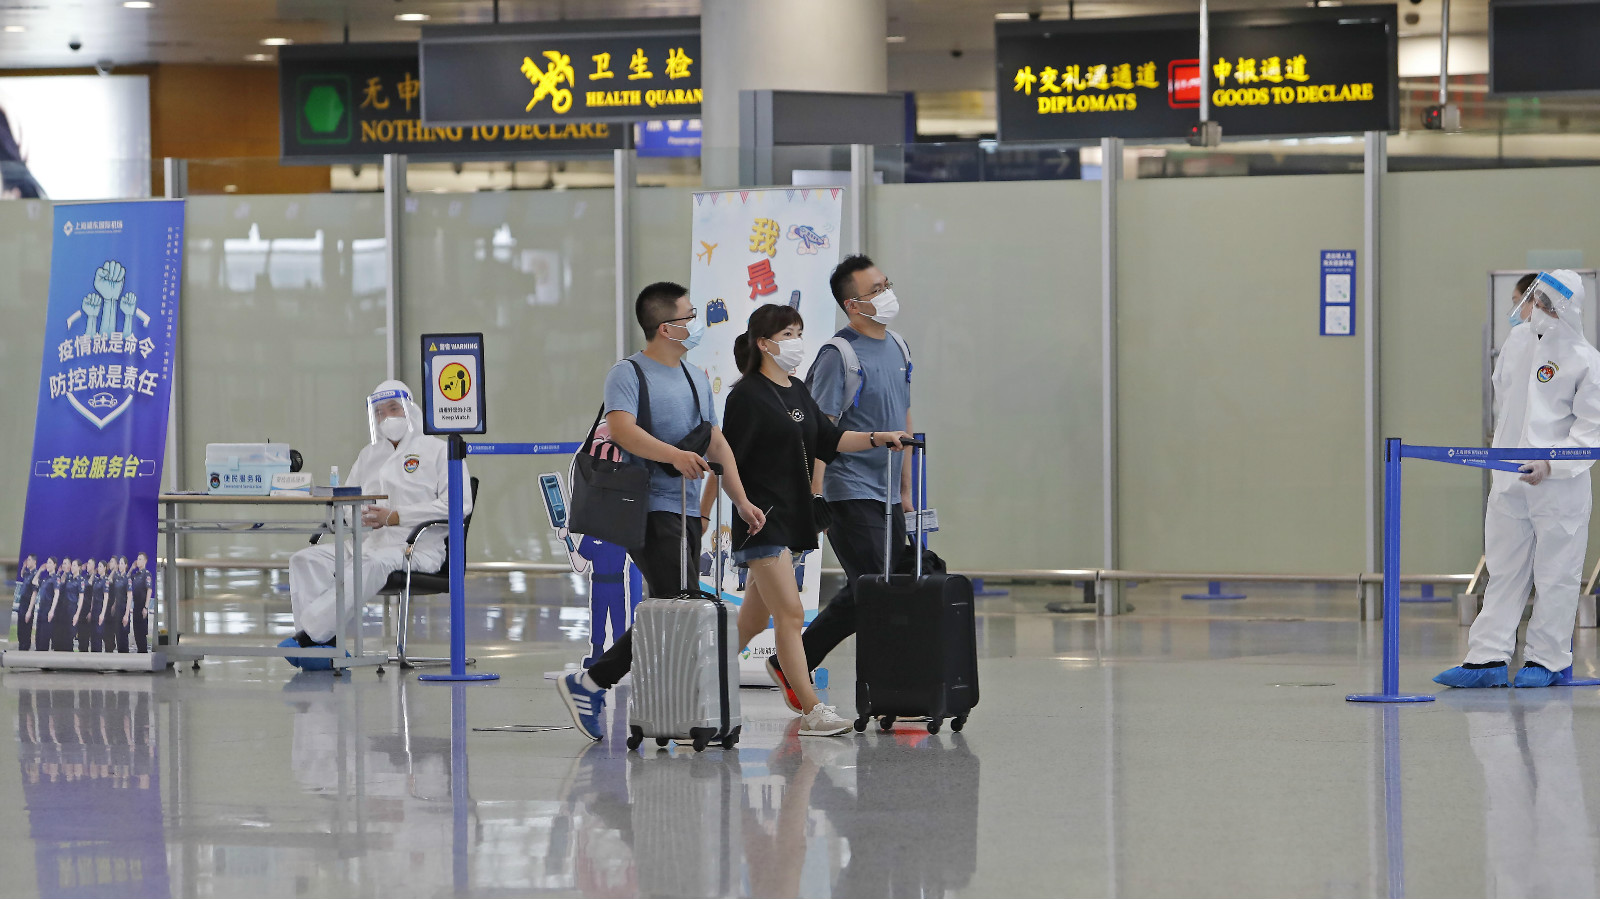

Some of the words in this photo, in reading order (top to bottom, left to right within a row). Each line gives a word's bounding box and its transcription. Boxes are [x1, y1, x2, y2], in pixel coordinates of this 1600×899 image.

[588, 47, 694, 81] 卫生检
[1013, 60, 1161, 96] 外交礼遇通道
[1213, 53, 1310, 86] 申报通道
[585, 89, 642, 107] HEALTH
[1037, 93, 1138, 115] DIPLOMATS
[1213, 86, 1269, 107] GOODS
[1272, 86, 1295, 105] TO
[1296, 83, 1374, 104] DECLARE
[361, 119, 463, 143] NOTHING
[471, 124, 499, 141] TO
[503, 122, 609, 140] DECLARE
[57, 331, 156, 363] 疫情就是命令
[49, 364, 160, 399] 防控就是责任
[50, 454, 140, 479] 安检服务台
